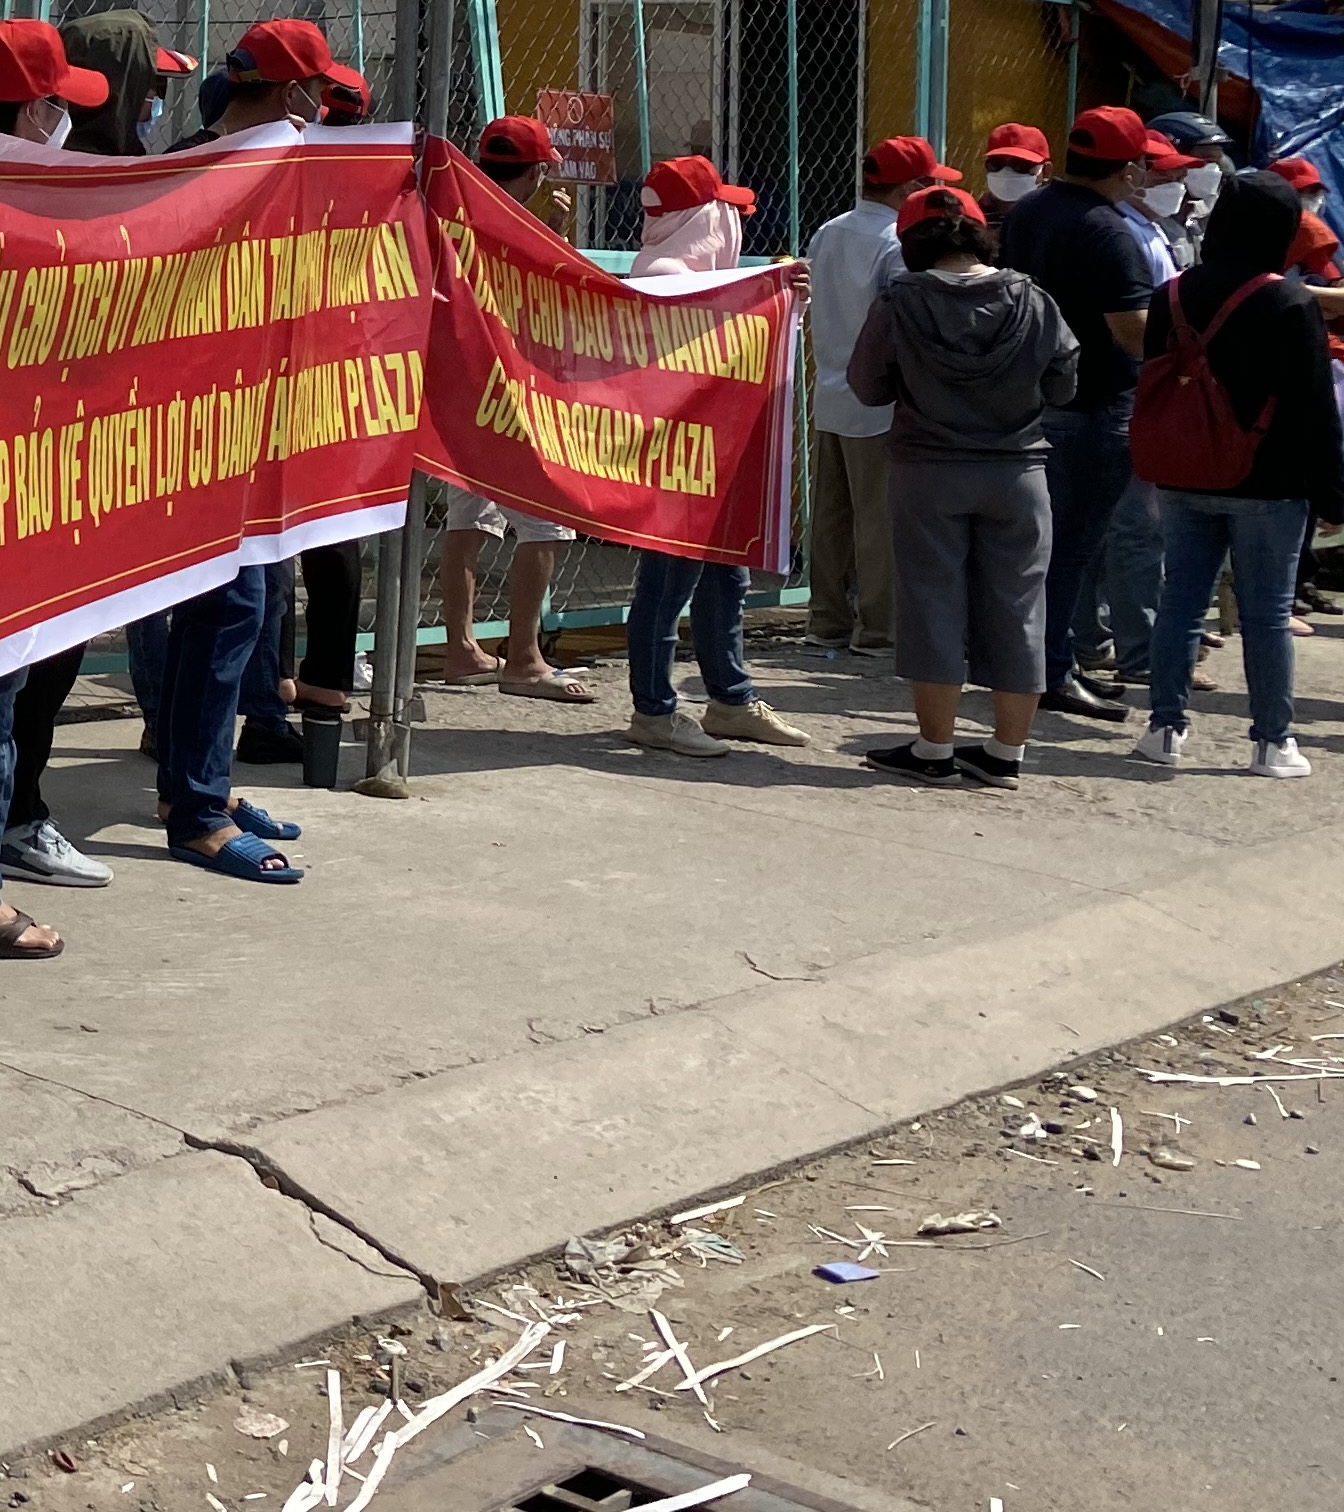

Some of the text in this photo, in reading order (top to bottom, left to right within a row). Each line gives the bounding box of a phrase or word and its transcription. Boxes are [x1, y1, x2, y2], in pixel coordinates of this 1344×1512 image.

[8, 229, 69, 370] CHỦ
[58, 260, 119, 383] TỊCH
[131, 252, 187, 347] BAN
[227, 221, 265, 331] DÂN
[372, 221, 419, 302] AN
[614, 293, 649, 369] TƯ
[648, 302, 769, 385] NAVILAND
[14, 395, 53, 540] BẢO
[60, 399, 84, 545] VỆ
[88, 376, 152, 528] QUYỀN
[156, 390, 186, 517] LỢI
[188, 383, 217, 489] CƯ
[218, 369, 253, 480] DÂN
[556, 399, 645, 486] ROXANA
[646, 416, 716, 498] PLAZA
